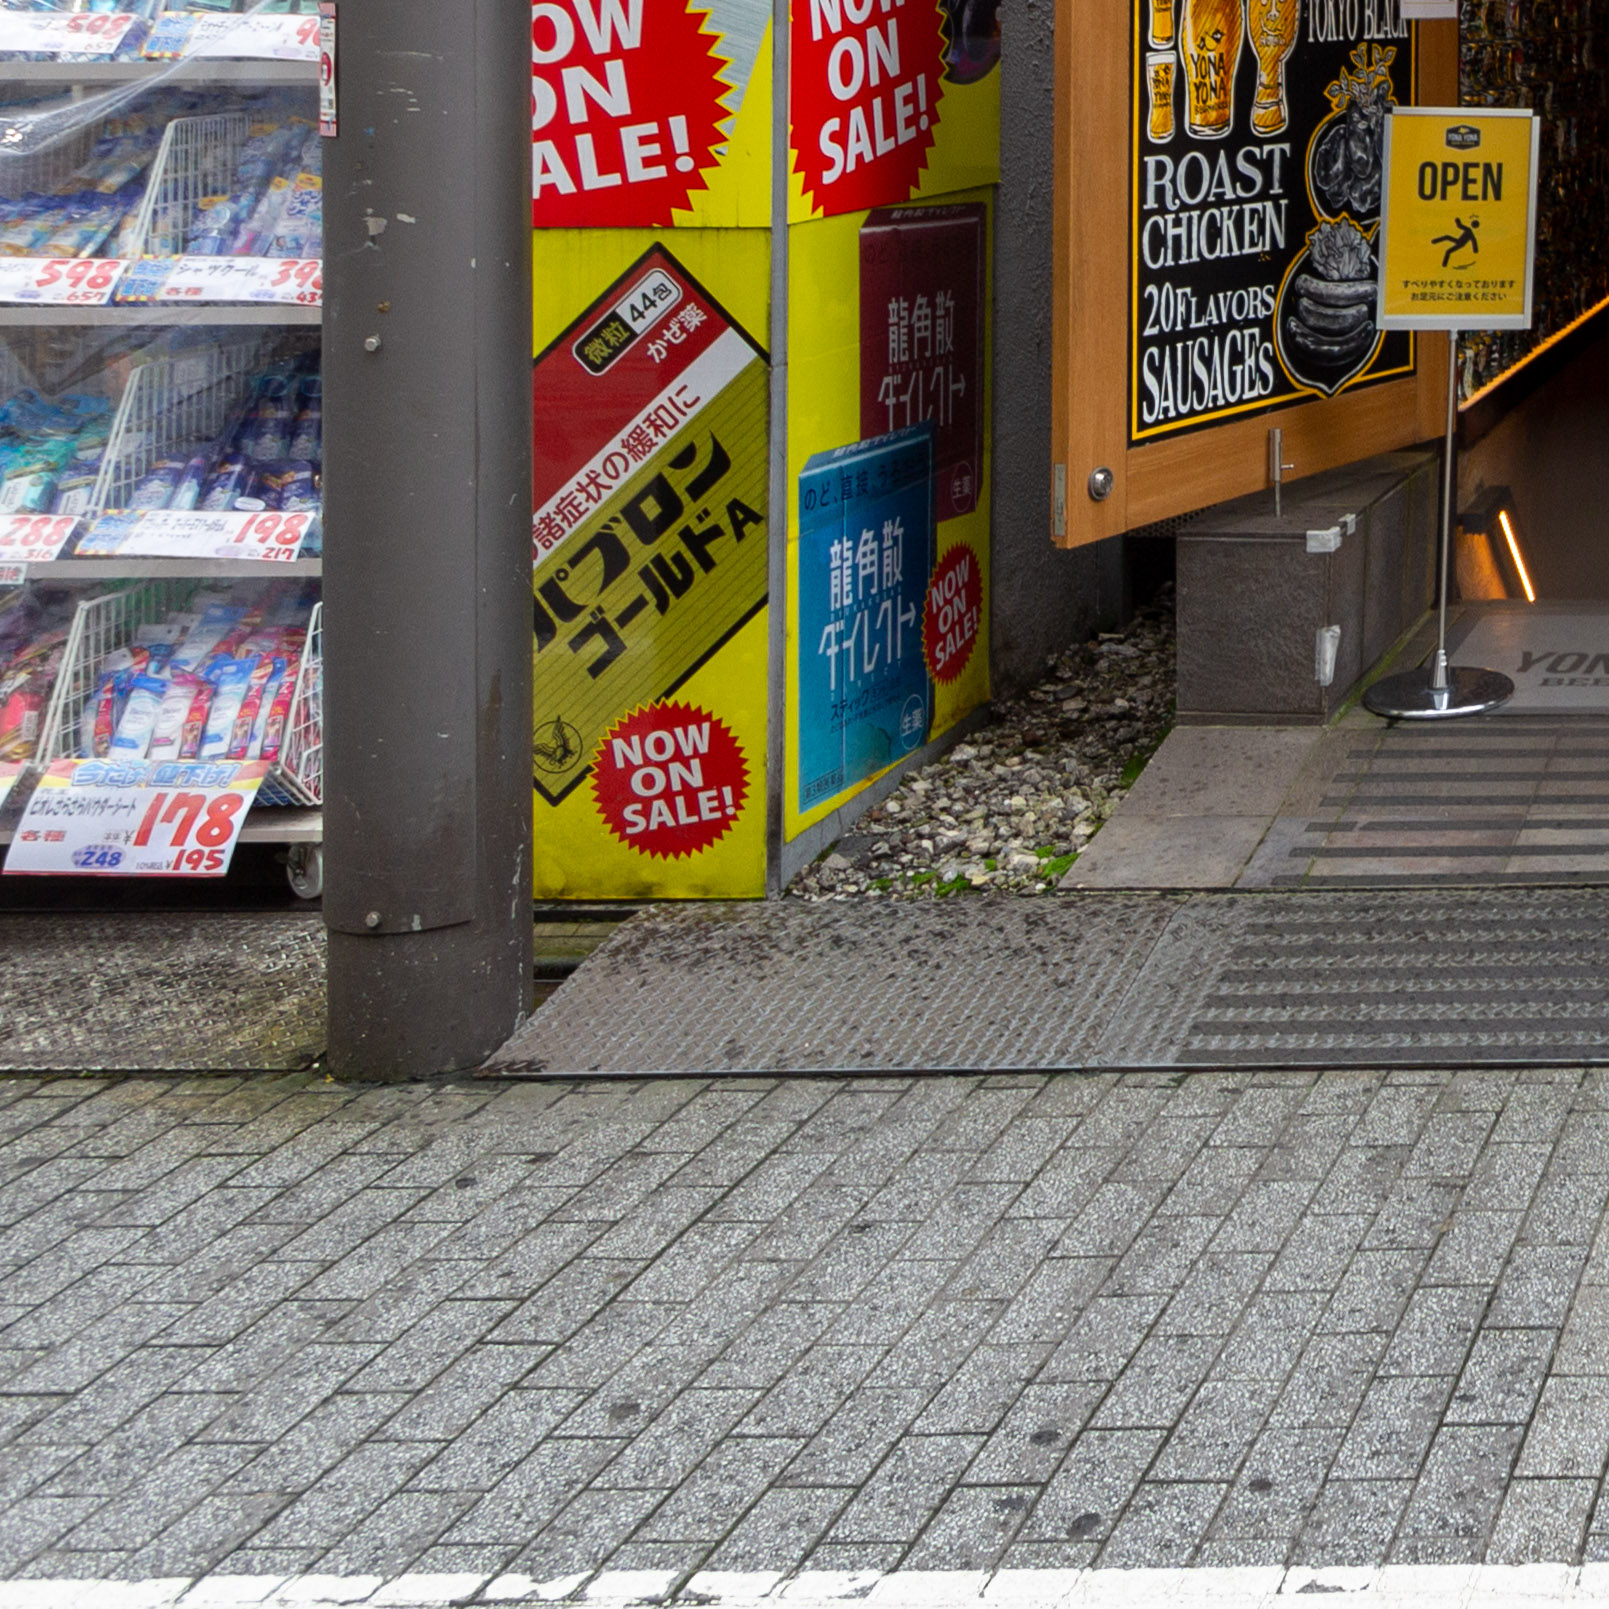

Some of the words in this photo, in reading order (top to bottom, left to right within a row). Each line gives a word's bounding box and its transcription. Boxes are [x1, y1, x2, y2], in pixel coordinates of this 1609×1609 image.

[827, 17, 902, 102] ON
[1190, 51, 1226, 81] YONA
[532, 115, 696, 200] ALE!
[820, 74, 930, 185] SALE!
[1143, 143, 1291, 211] ROAST
[1417, 160, 1504, 202] OPEN
[1142, 198, 1289, 270] CHICKEN
[35, 260, 121, 290] 598
[1402, 279, 1516, 290] すべりやすくなっております
[1410, 292, 1507, 302] お足元にご注意ください
[646, 301, 708, 364] かぜ薬
[887, 289, 955, 365] 龍角散
[0, 516, 75, 546] 288
[234, 513, 309, 545] 198
[262, 547, 295, 561] 217
[533, 429, 733, 654] パブロン
[567, 497, 765, 680] ゴールドA
[829, 515, 904, 612] 龍角散
[931, 554, 971, 613] NOW
[935, 606, 979, 672] SALE!
[938, 589, 967, 635] ON
[817, 593, 917, 691] ダイレクト
[611, 722, 712, 768] NOW
[630, 756, 704, 798] ON
[133, 791, 245, 848] 178
[621, 786, 736, 836] SALE!
[82, 850, 123, 868] 248
